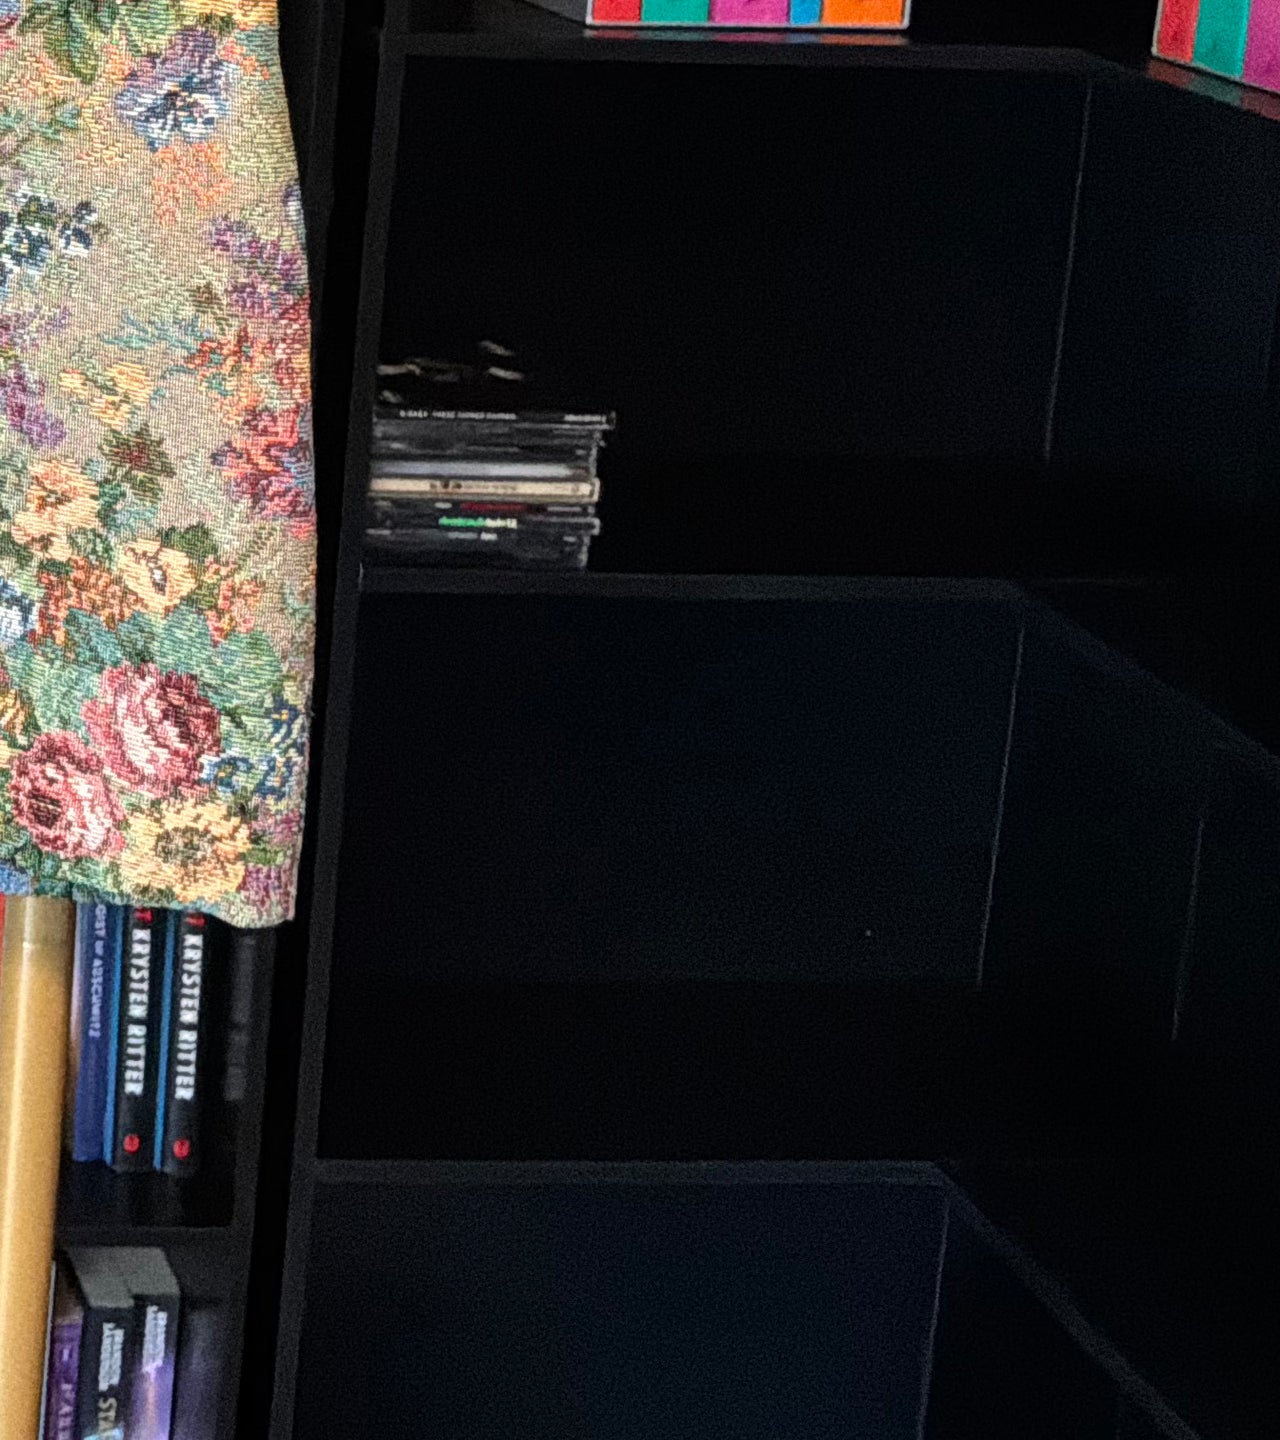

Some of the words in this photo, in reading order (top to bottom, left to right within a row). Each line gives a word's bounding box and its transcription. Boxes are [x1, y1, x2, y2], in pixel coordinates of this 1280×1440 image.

[132, 928, 152, 1018] KRYSTEN
[180, 934, 204, 1034] KRYSTEN
[124, 1024, 148, 1097] RITTER
[174, 1036, 199, 1101] RITTER
